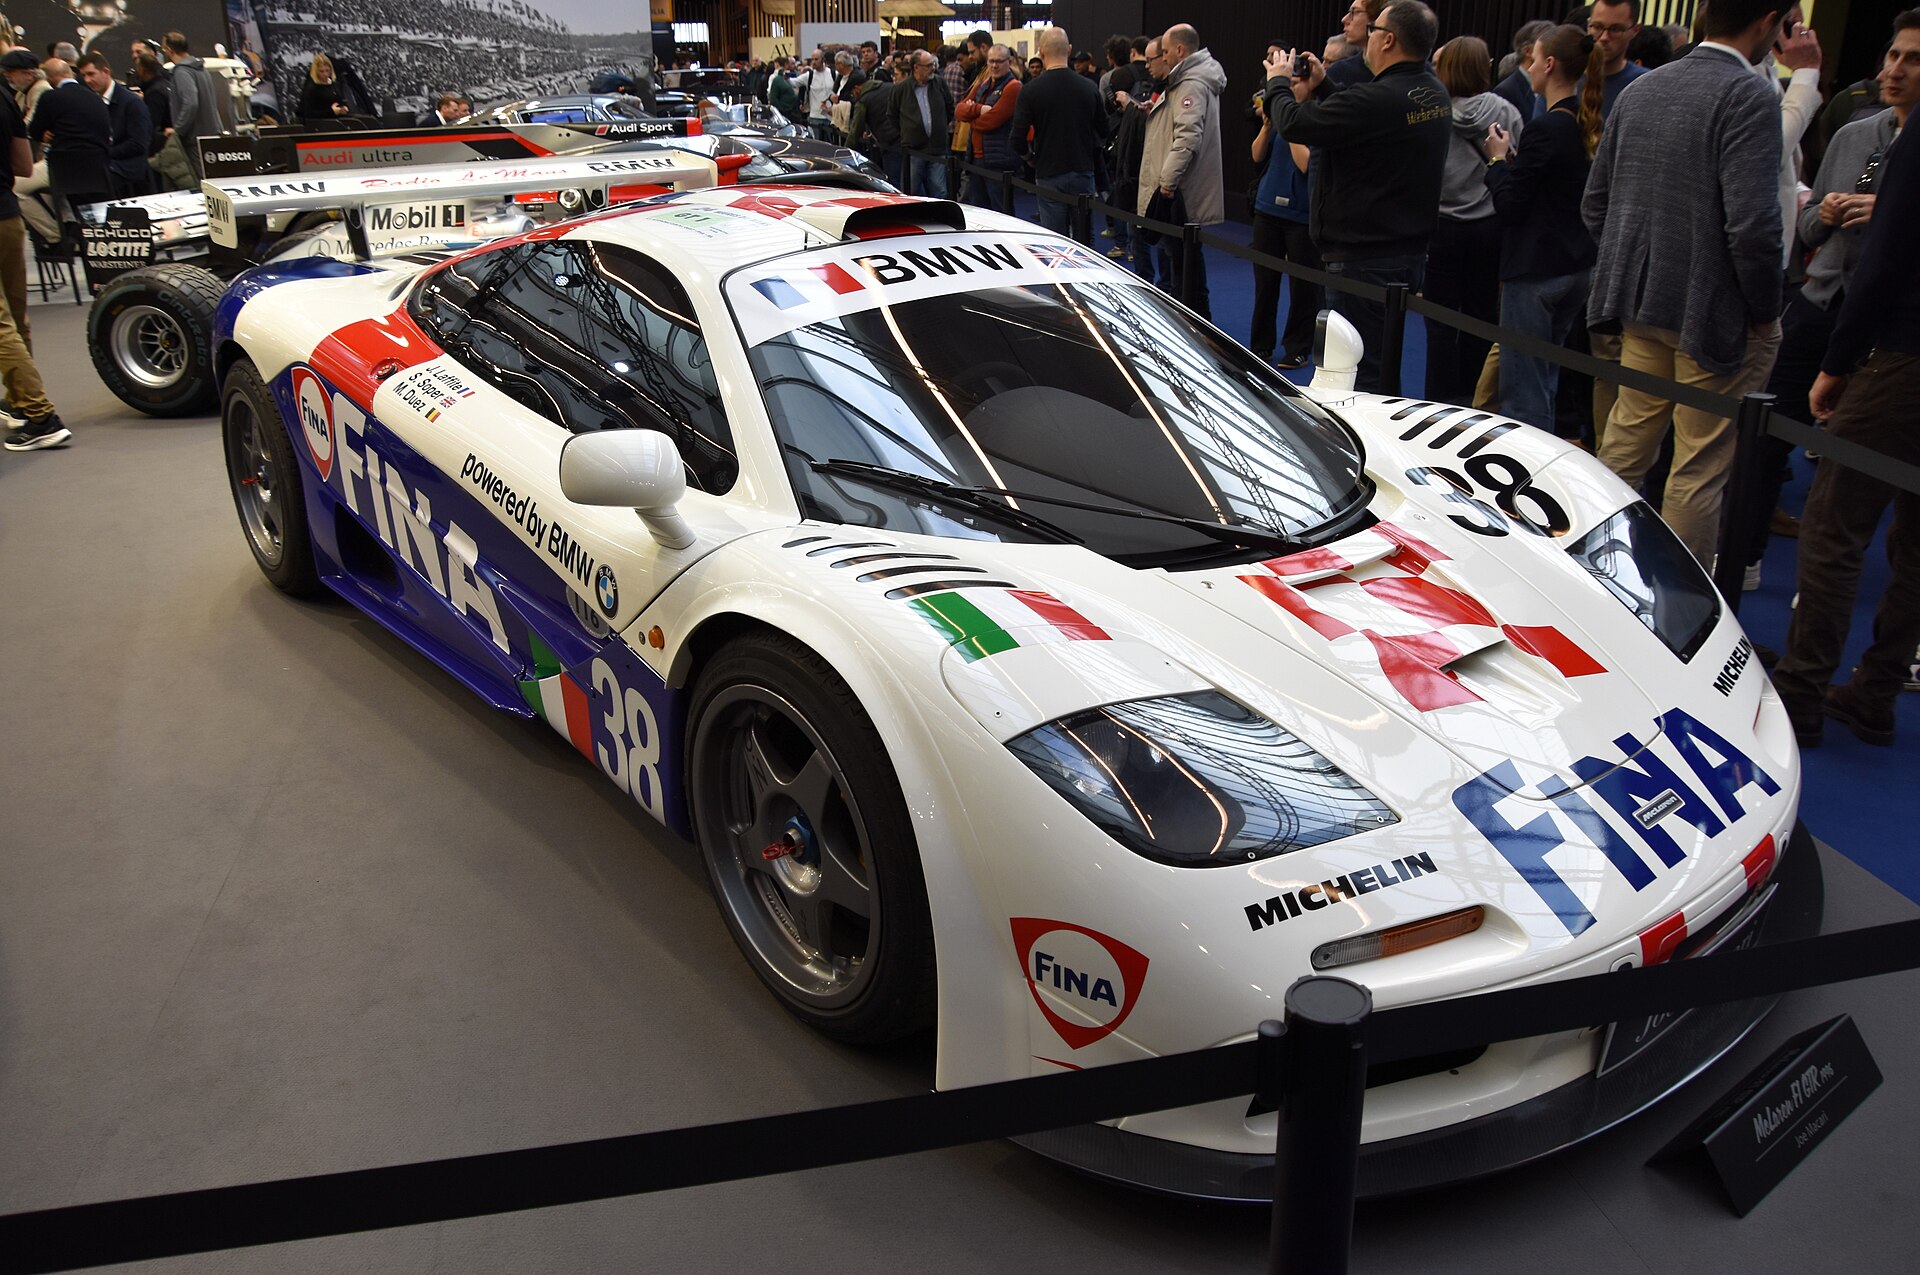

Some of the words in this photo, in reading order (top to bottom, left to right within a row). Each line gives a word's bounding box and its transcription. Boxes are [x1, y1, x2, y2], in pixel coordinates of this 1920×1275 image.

[610, 123, 638, 134] Audi
[639, 122, 674, 134] Sport
[216, 151, 252, 162] BOSCH
[302, 151, 353, 166] Audi
[362, 149, 413, 164] ultra
[586, 157, 676, 172] BMW
[206, 195, 230, 224] BMW
[371, 204, 436, 231] Mobil
[81, 228, 152, 238] SCHUCO
[86, 241, 151, 257] LOCTITE
[88, 259, 148, 269] WARSTEINER
[851, 243, 1024, 286] BMW
[425, 365, 441, 374] J.
[432, 369, 463, 392] Laffite
[392, 381, 409, 397] M.
[402, 389, 427, 413] Duez
[408, 372, 423, 384] S.
[417, 378, 445, 400] Soper
[301, 395, 330, 443] FINA
[1405, 453, 1571, 539] 38
[333, 392, 510, 656] FINA
[460, 452, 531, 527] powered
[526, 502, 548, 549] by
[547, 521, 595, 588] BMW
[1712, 635, 1753, 698] MICHELIN
[591, 657, 667, 827] 38
[1452, 707, 1782, 939] FINA
[1642, 796, 1678, 822] McLaren
[1243, 851, 1439, 932] MICHELIN
[1035, 951, 1118, 1008] FINA
[1752, 1099, 1795, 1145] McLaren
[1801, 1064, 1822, 1099] GTR
[1794, 1131, 1810, 1149] Joe
